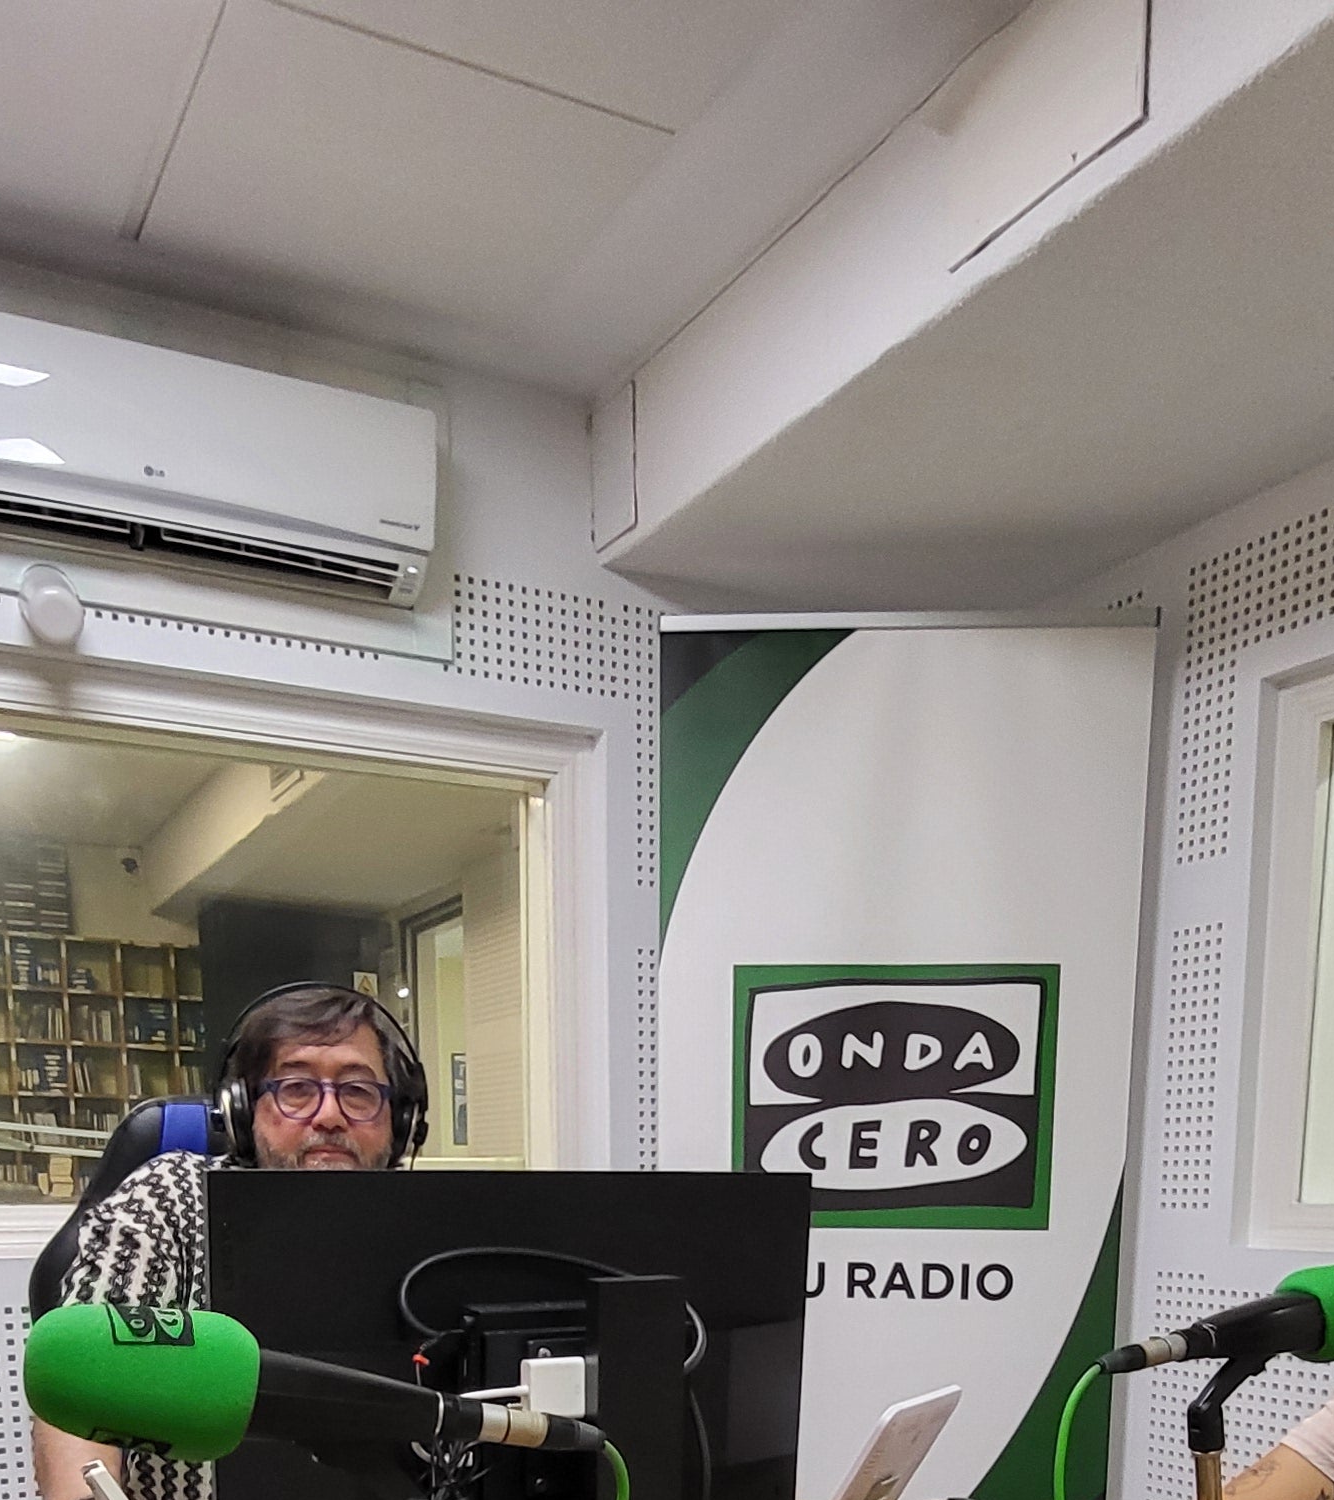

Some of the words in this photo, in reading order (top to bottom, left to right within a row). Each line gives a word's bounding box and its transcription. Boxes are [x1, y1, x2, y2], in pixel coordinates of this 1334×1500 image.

[788, 1031, 995, 1078] ONDA
[798, 1119, 992, 1171] CERO
[804, 1262, 826, 1298] U
[847, 1262, 1014, 1301] RADIO
